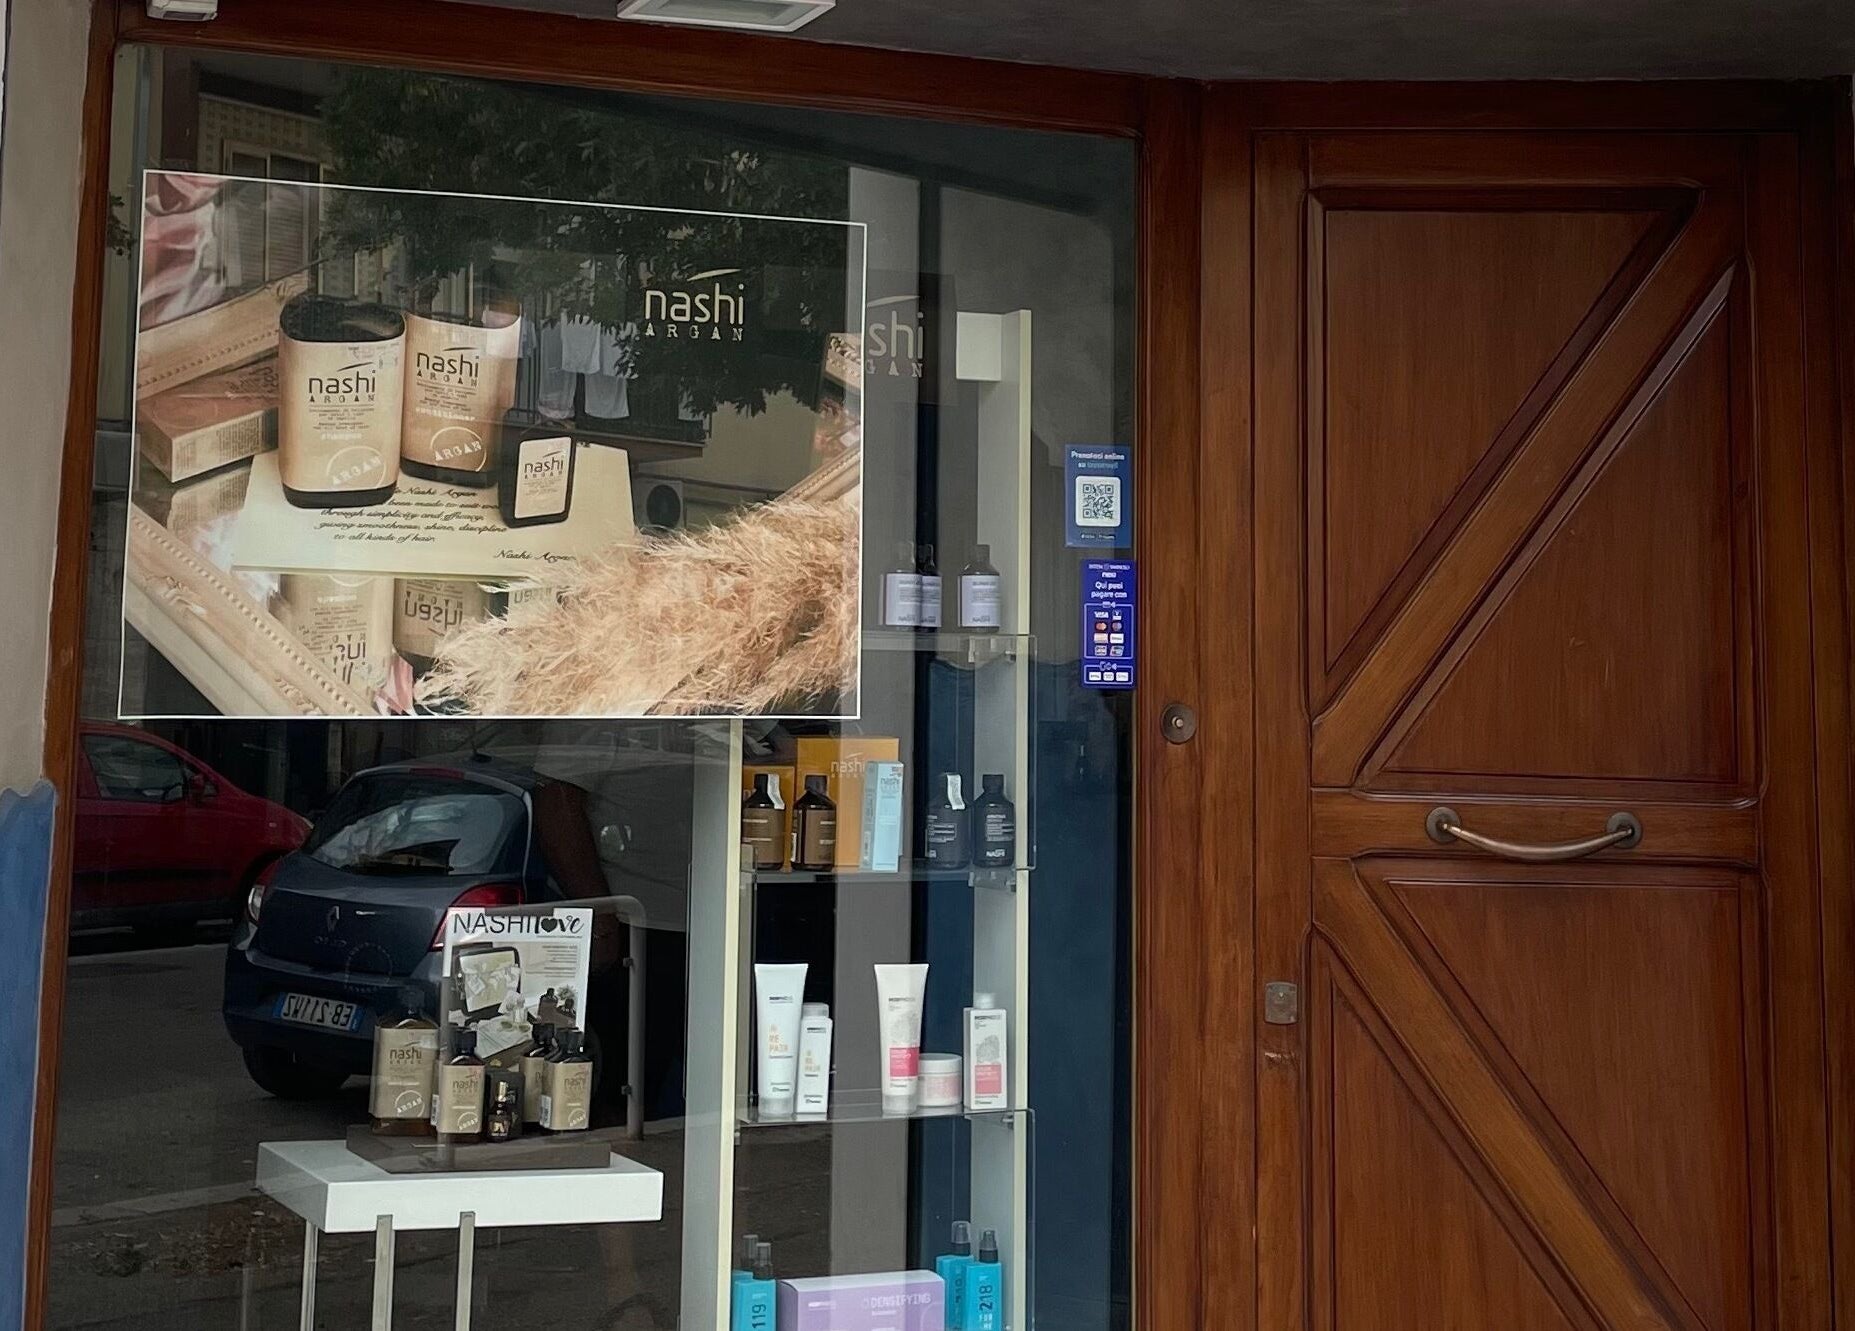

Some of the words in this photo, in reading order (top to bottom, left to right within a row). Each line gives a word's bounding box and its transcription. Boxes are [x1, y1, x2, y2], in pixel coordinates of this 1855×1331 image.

[644, 282, 744, 325] nashi
[645, 322, 744, 342] ARGAN
[867, 310, 924, 359] shi
[416, 352, 480, 378] nashi
[308, 370, 376, 394] nashi
[416, 369, 479, 388] ARGAN
[309, 394, 376, 404] ARGAN
[434, 440, 482, 462] ARGAN
[332, 455, 381, 486] ARGAN
[524, 456, 565, 475] nashi
[320, 508, 365, 520] through
[493, 549, 532, 561] Nashi
[1091, 591, 1113, 599] pagare
[1095, 581, 1107, 590] Qui
[389, 1046, 422, 1060] nashi
[978, 1284, 994, 1312] 218
[751, 1304, 767, 1329] 119
